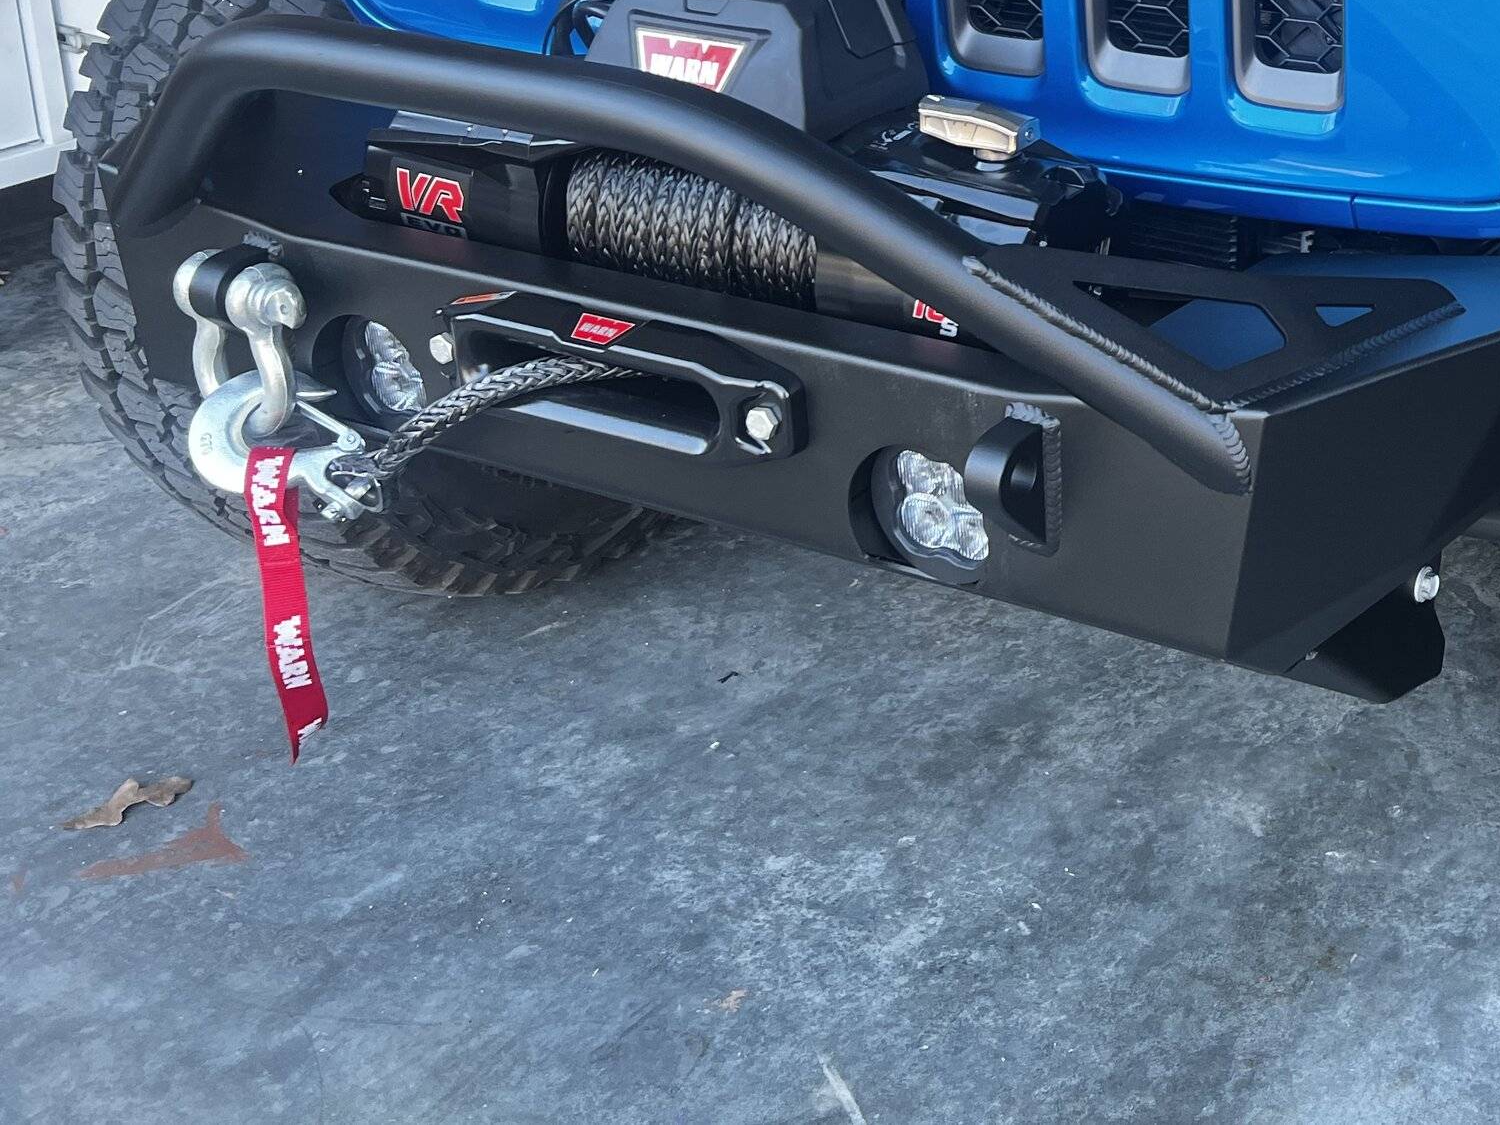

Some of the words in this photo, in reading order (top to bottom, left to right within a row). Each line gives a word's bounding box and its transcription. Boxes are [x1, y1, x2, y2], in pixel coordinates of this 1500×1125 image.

[648, 52, 720, 87] WARN
[396, 166, 465, 224] VR
[250, 455, 291, 547] WARN
[273, 614, 313, 690] WARN
